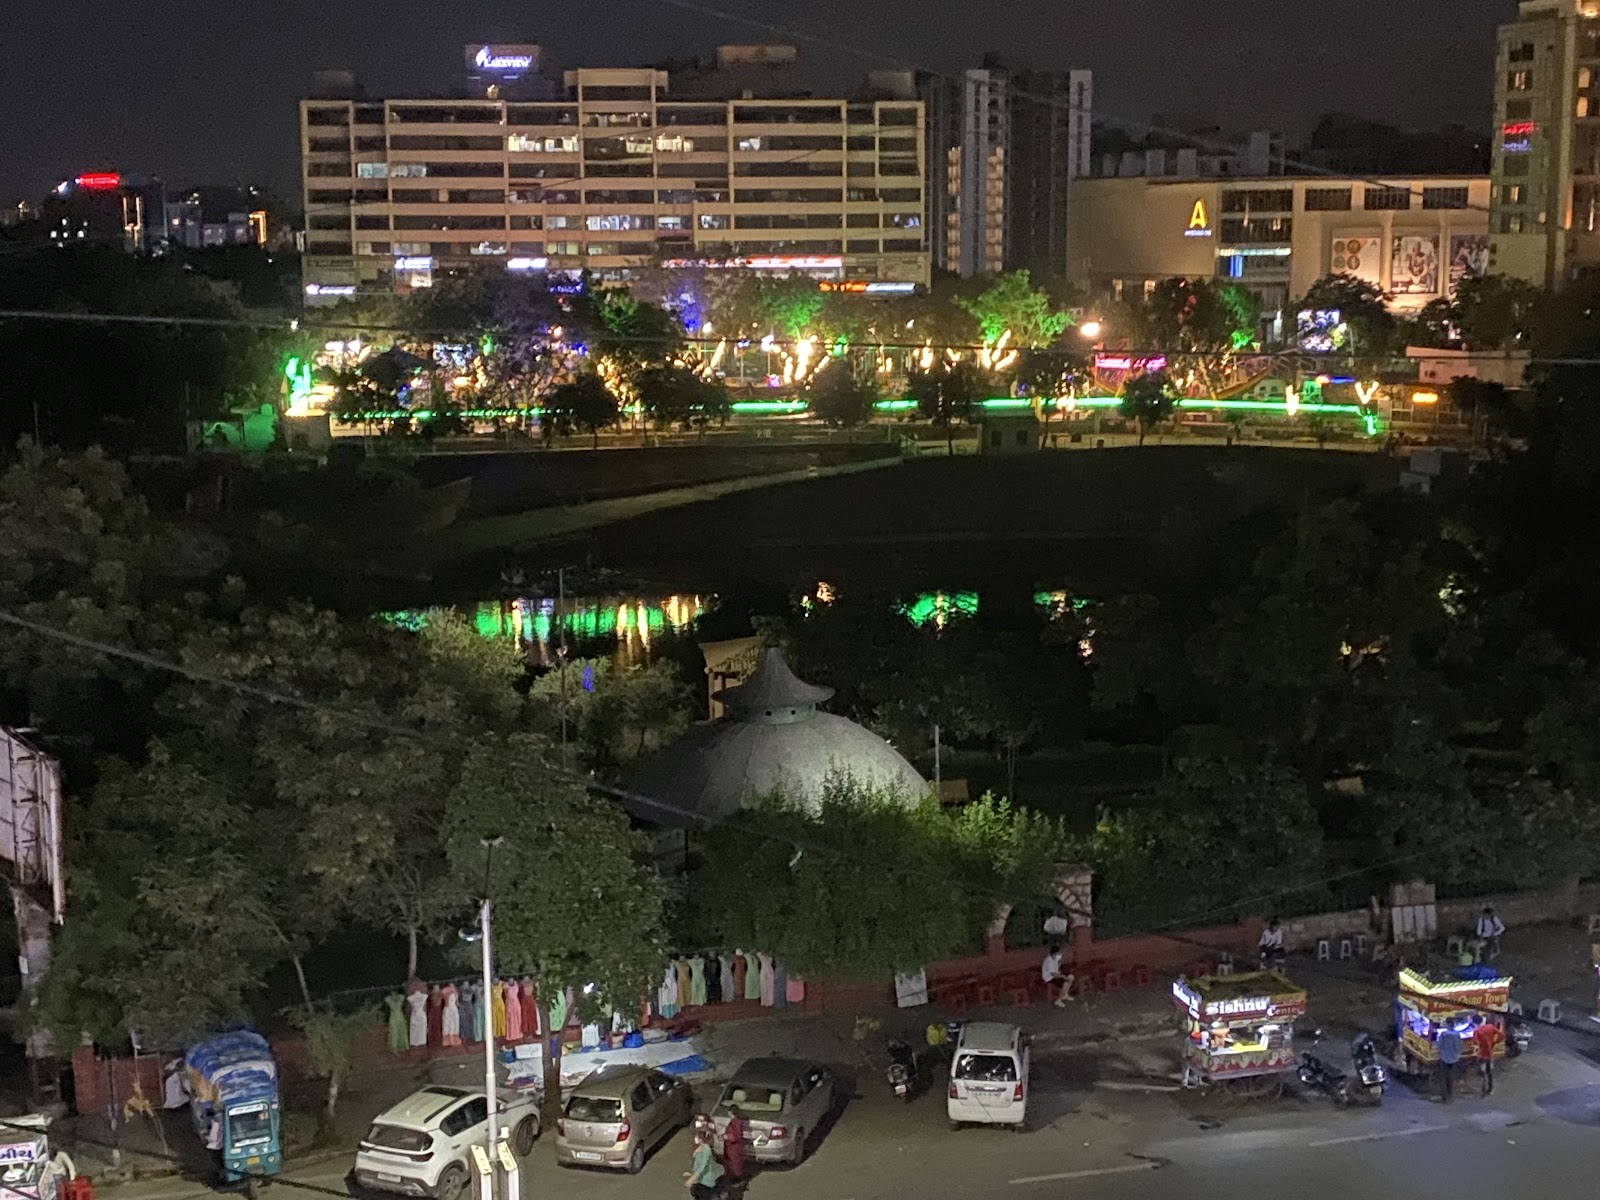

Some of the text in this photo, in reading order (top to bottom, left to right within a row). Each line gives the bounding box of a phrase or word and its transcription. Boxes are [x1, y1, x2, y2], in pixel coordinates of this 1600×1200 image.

[484, 57, 530, 68] LAKEVIEW
[1189, 197, 1208, 229] A
[1484, 993, 1507, 1003] Town
